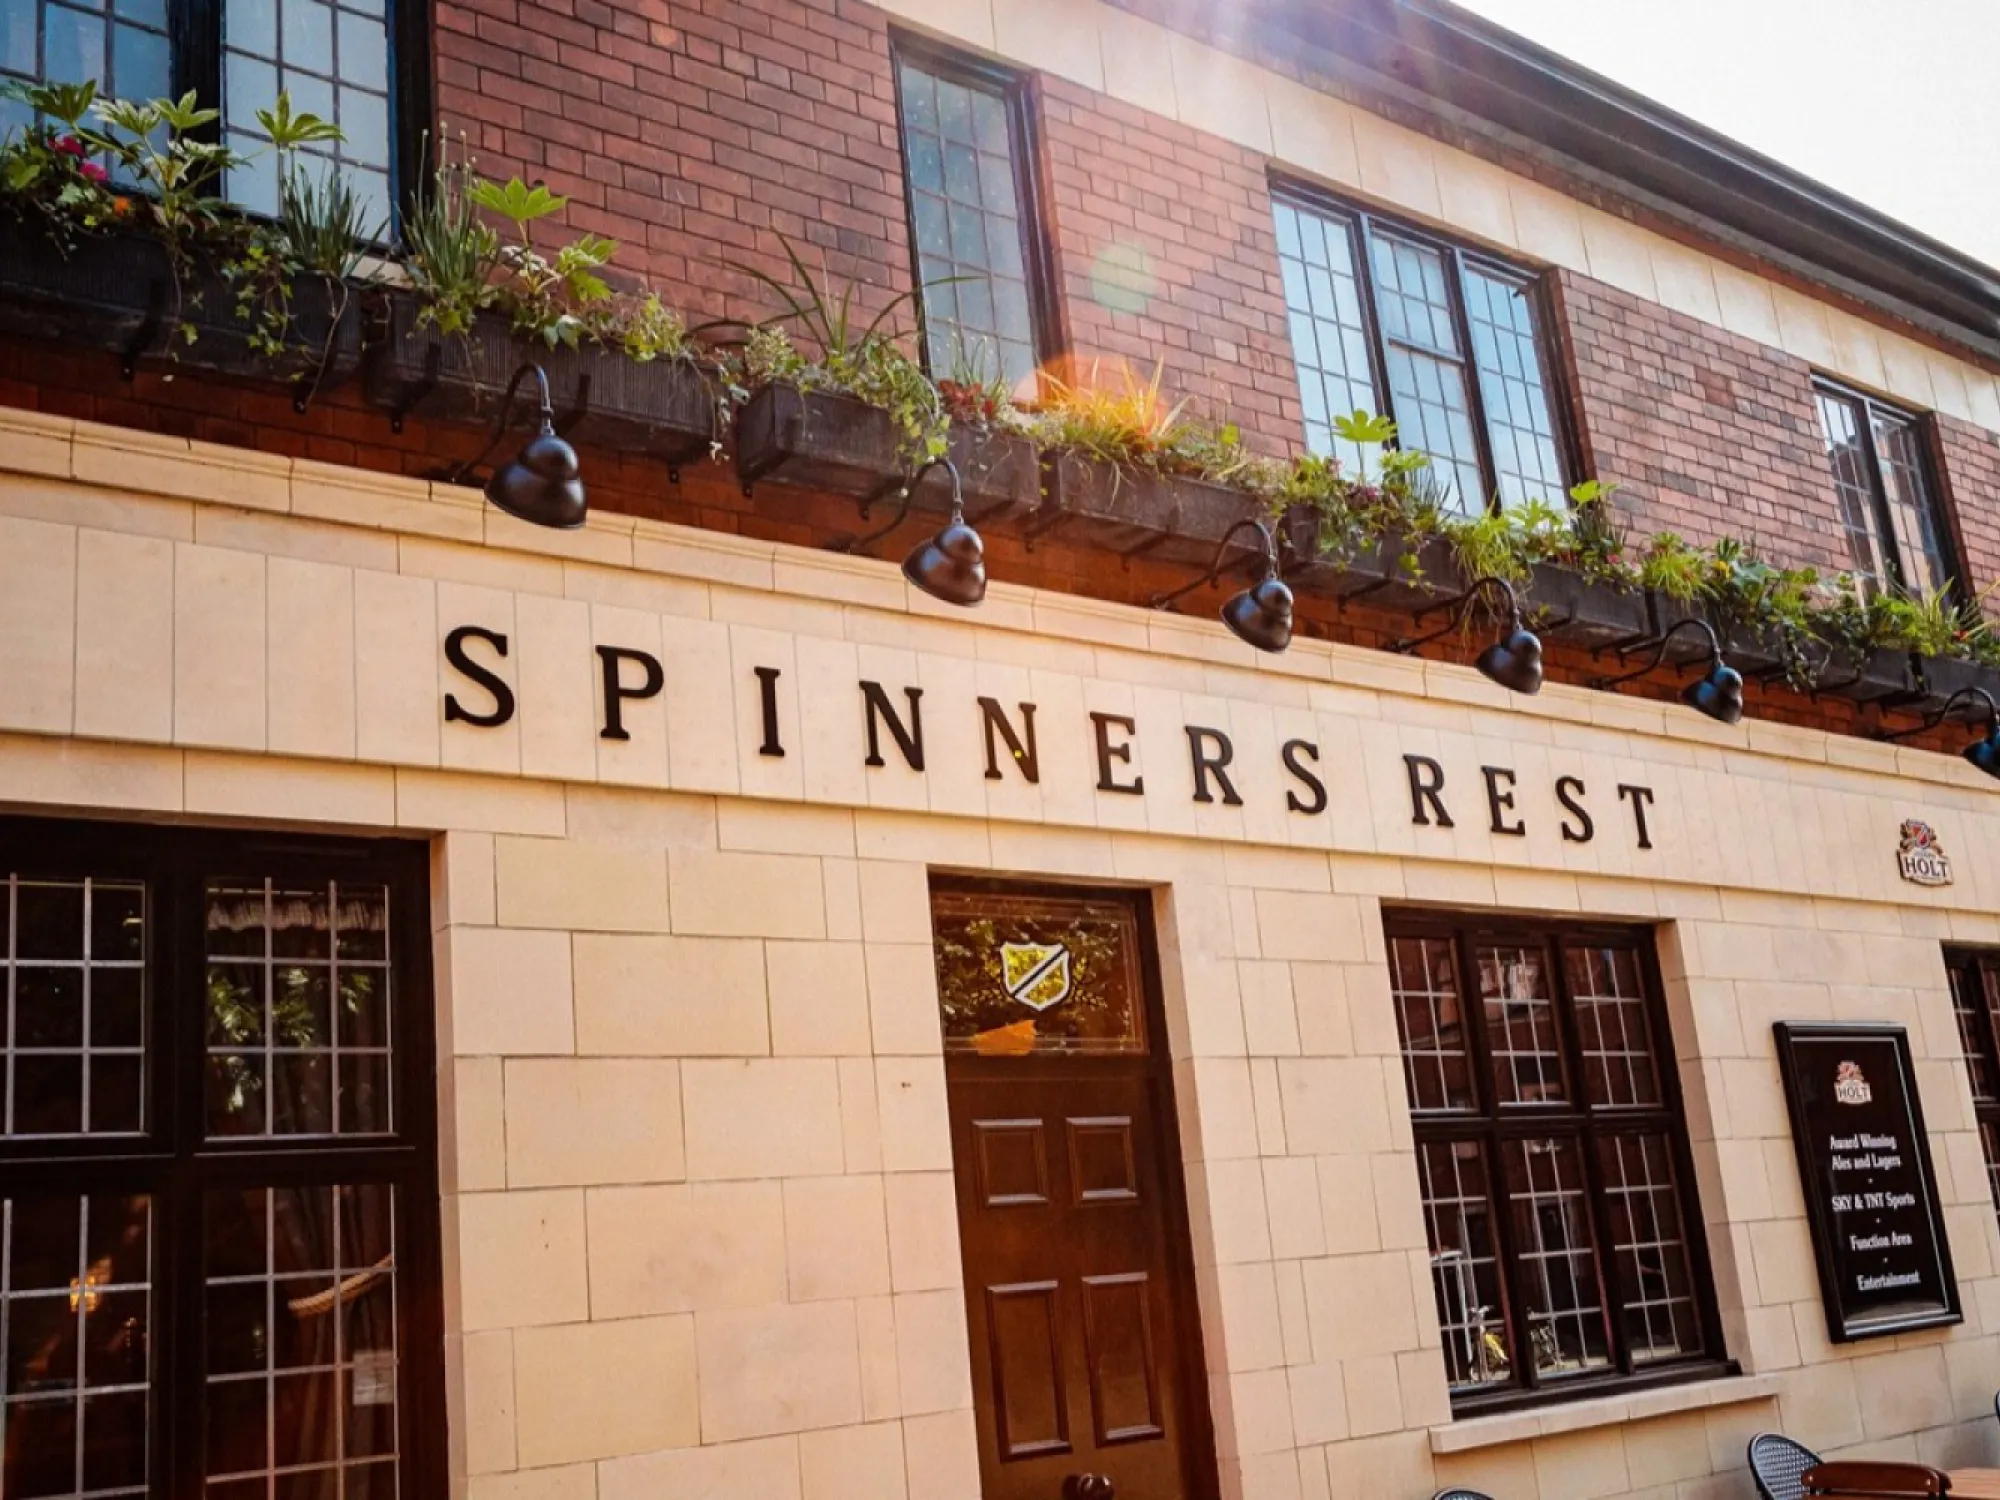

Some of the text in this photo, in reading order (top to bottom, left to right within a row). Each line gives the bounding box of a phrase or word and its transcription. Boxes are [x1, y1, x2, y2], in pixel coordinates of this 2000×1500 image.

[444, 625, 1655, 850] SPINNERS REST
[1904, 857, 1949, 877] HOLT
[1838, 1086, 1868, 1099] HOLT
[1830, 1133, 1898, 1151] Award Winning
[1832, 1152, 1902, 1171] Ales and Lagers
[1832, 1191, 1916, 1212] SKY & TNT Sports
[1849, 1230, 1913, 1251] Function Area
[1856, 1268, 1922, 1291] Entertainment
